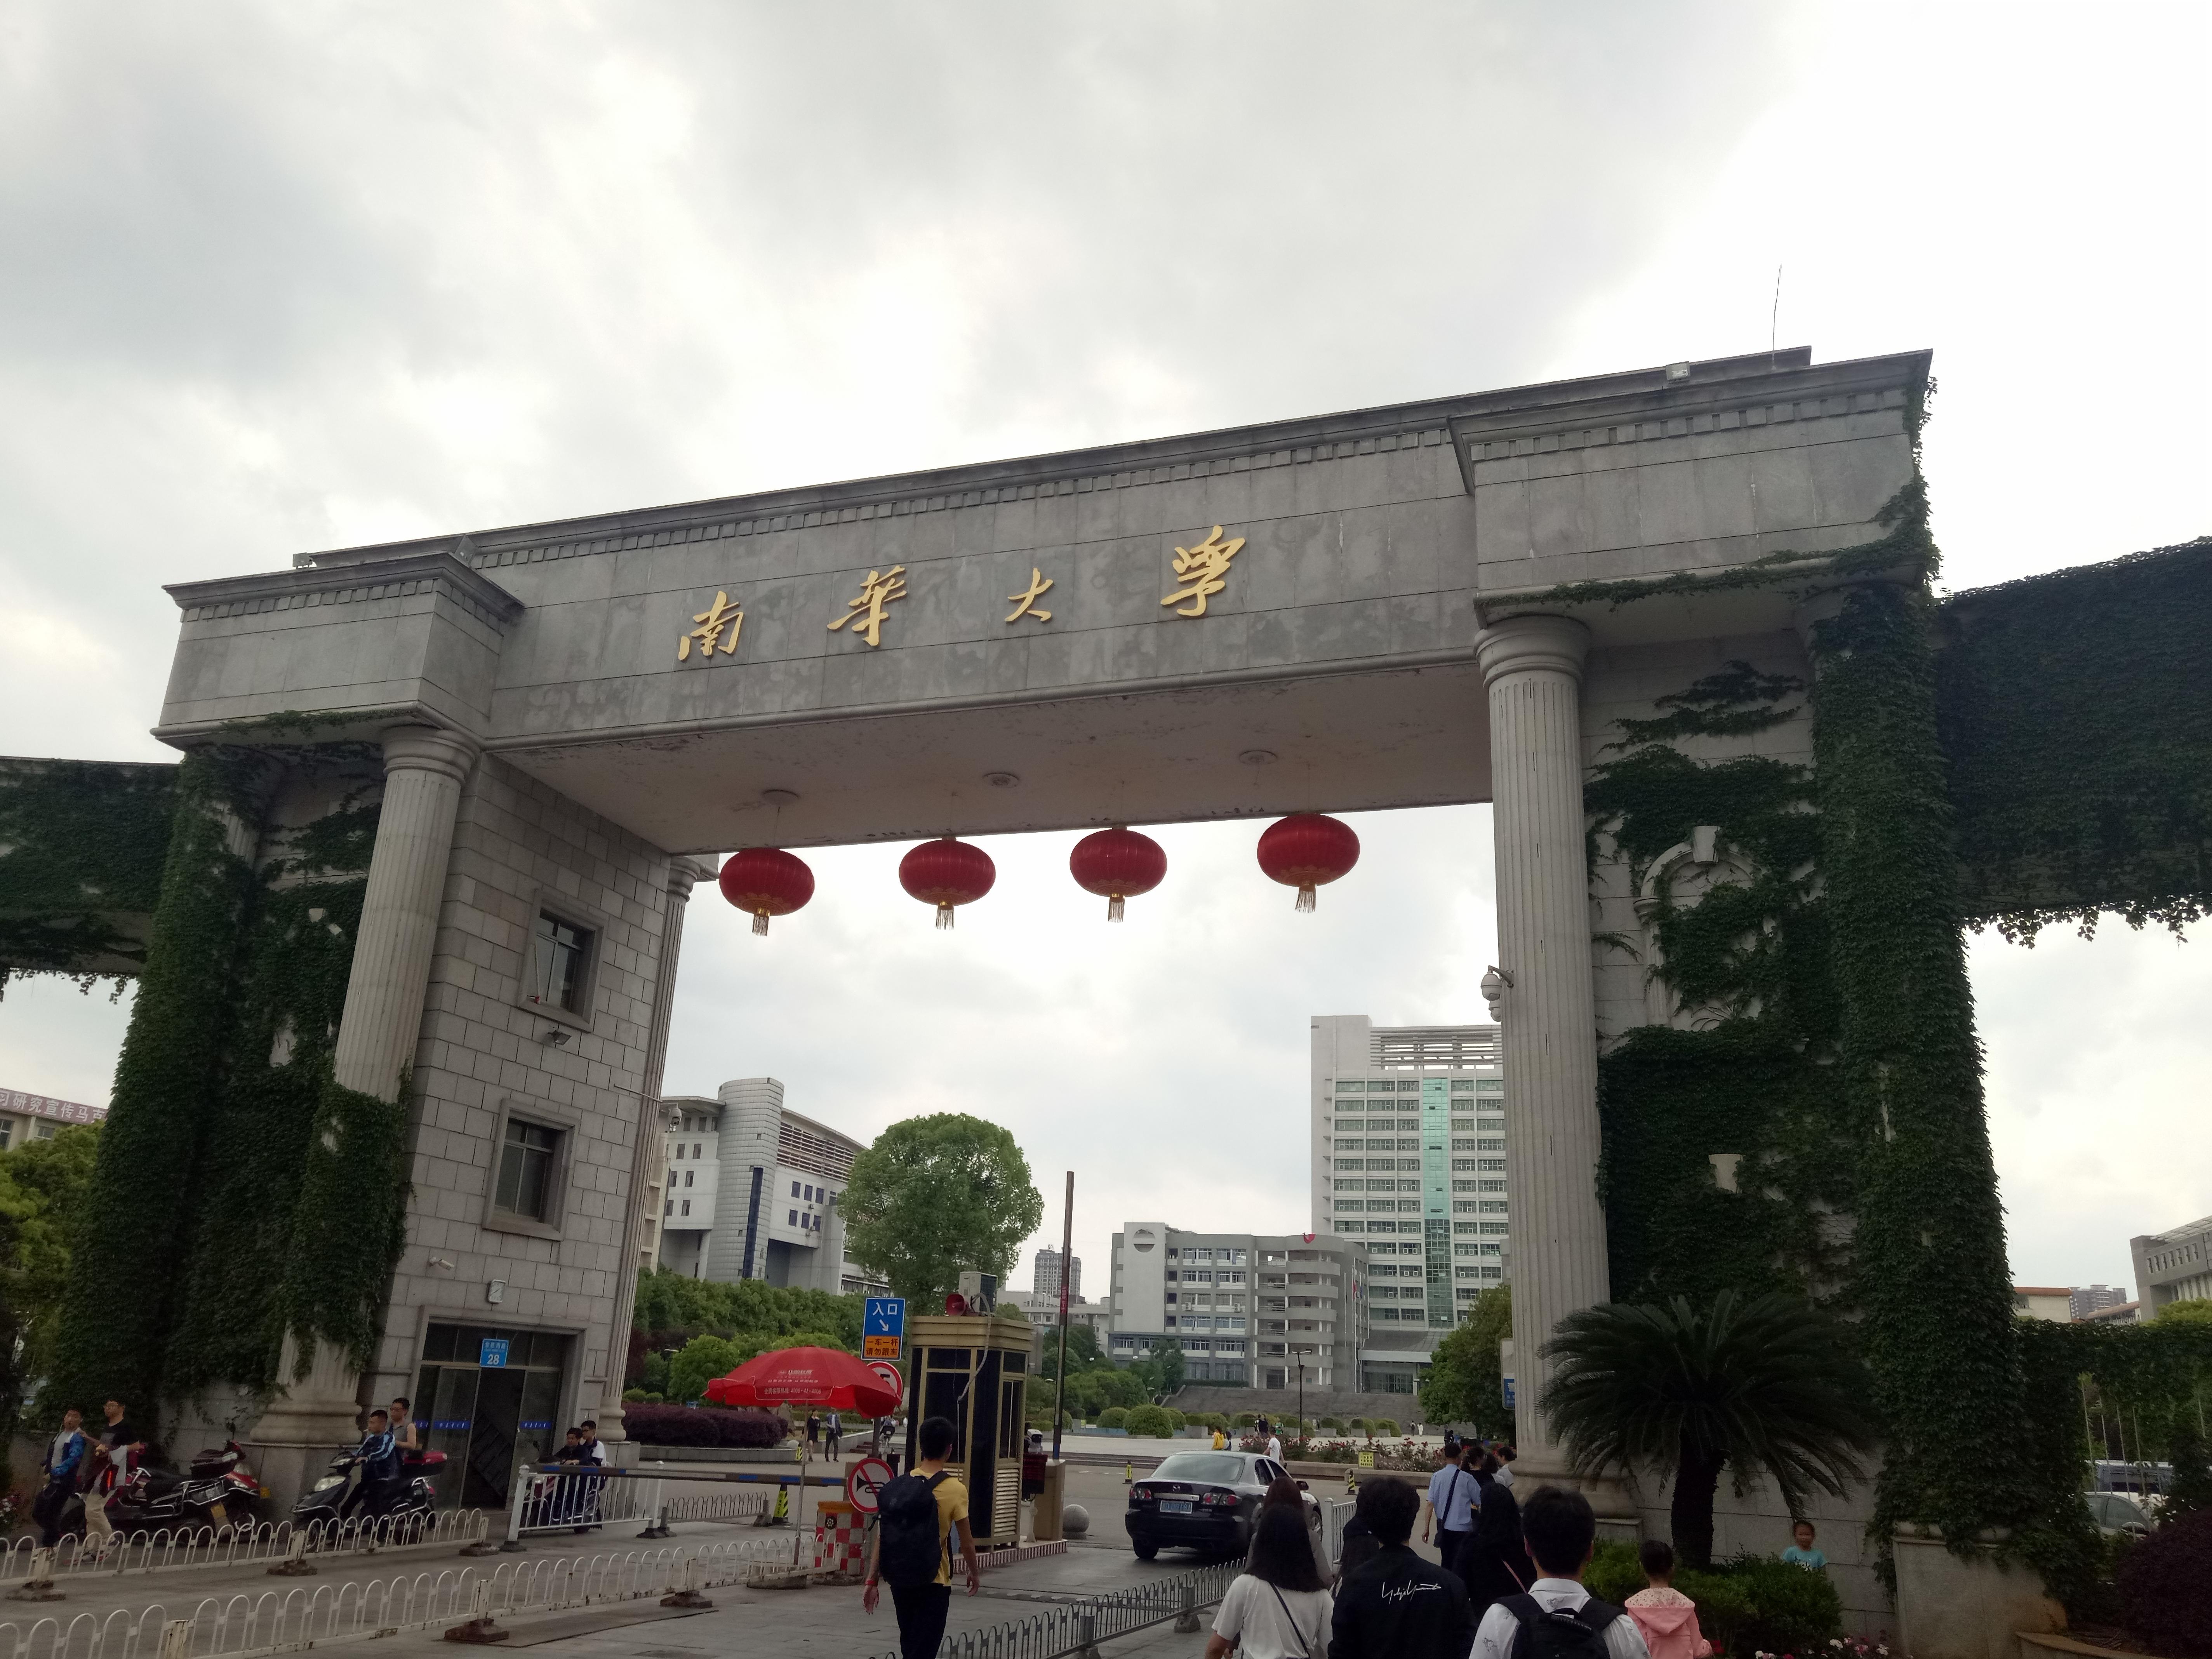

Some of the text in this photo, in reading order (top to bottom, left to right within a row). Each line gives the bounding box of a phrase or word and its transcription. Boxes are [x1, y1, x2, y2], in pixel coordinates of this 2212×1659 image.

[872, 1302, 897, 1316] 入口
[866, 1348, 897, 1356] 请勿跟车
[487, 1353, 500, 1365] 28
